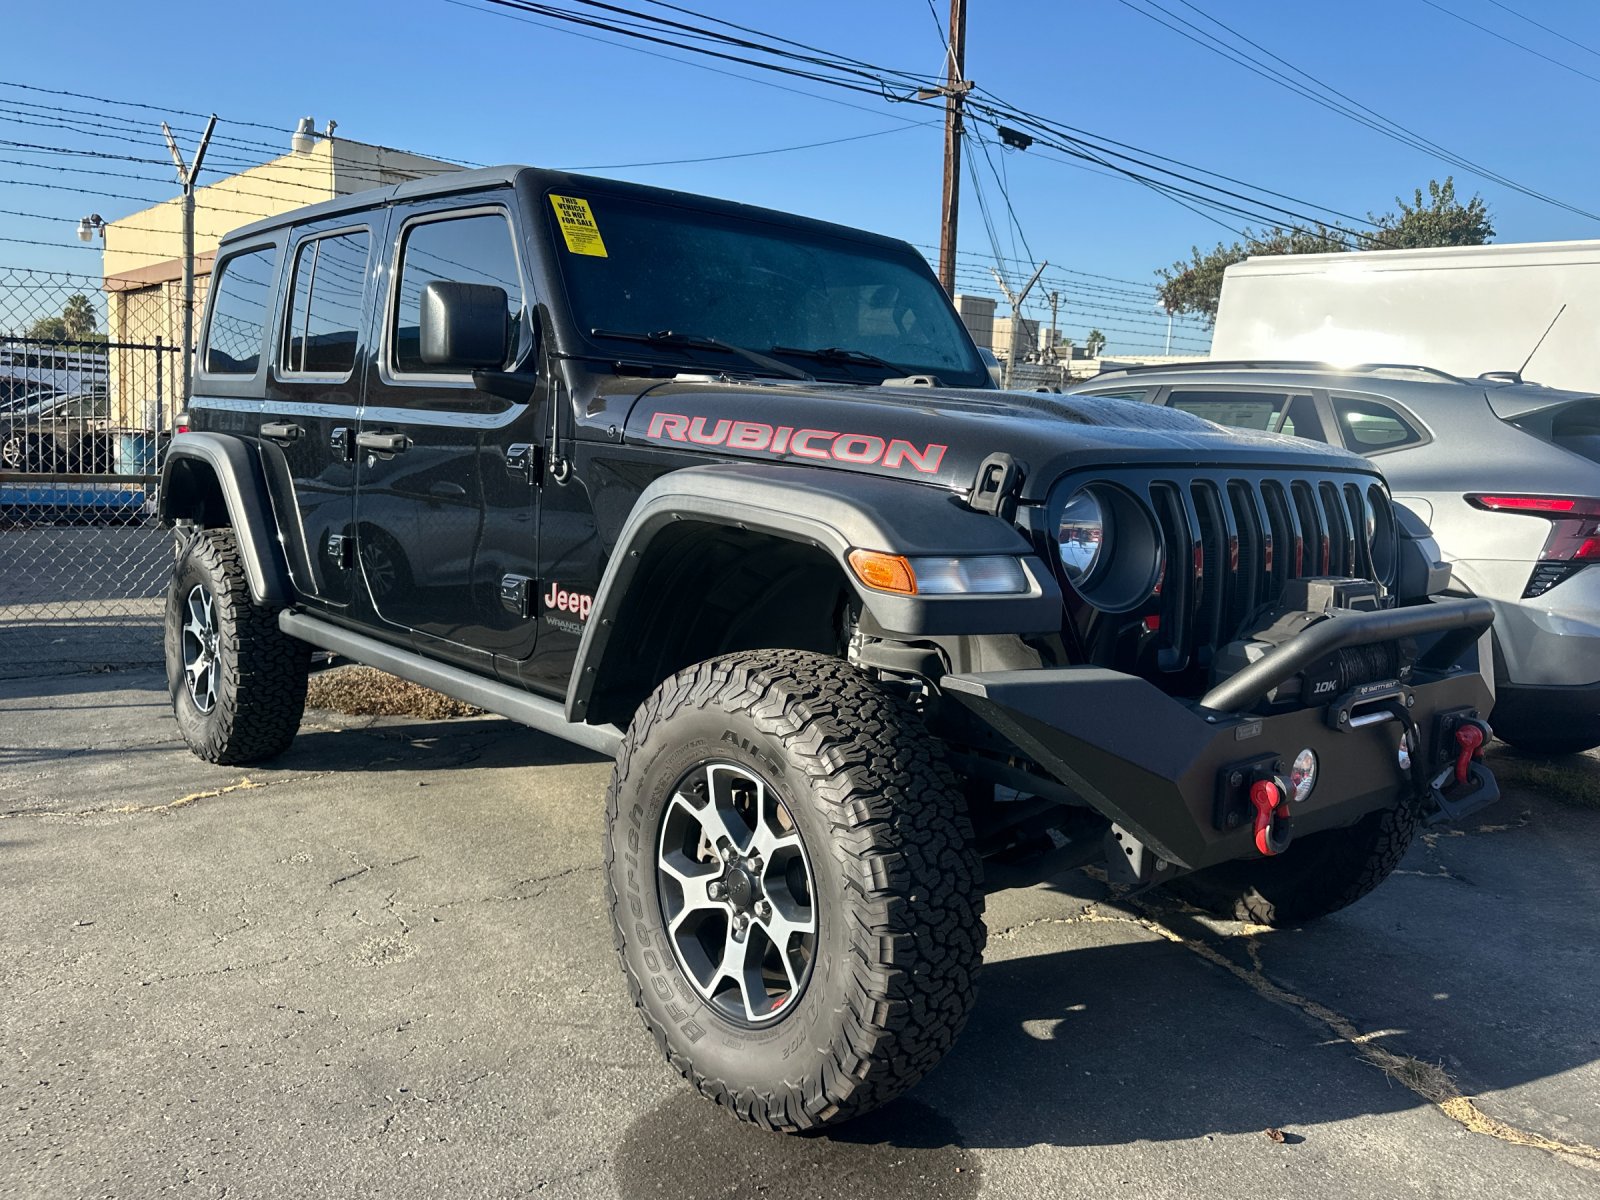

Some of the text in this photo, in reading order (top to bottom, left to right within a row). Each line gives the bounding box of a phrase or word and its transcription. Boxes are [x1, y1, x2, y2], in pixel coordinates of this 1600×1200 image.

[557, 203, 586, 212] VEHICLE
[561, 197, 577, 205] THIS
[561, 216, 575, 224] FOR
[647, 412, 948, 474] RUBICON
[544, 582, 593, 621] Jeep
[1314, 680, 1337, 693] 10K
[625, 801, 706, 1045] BFGoodrich
